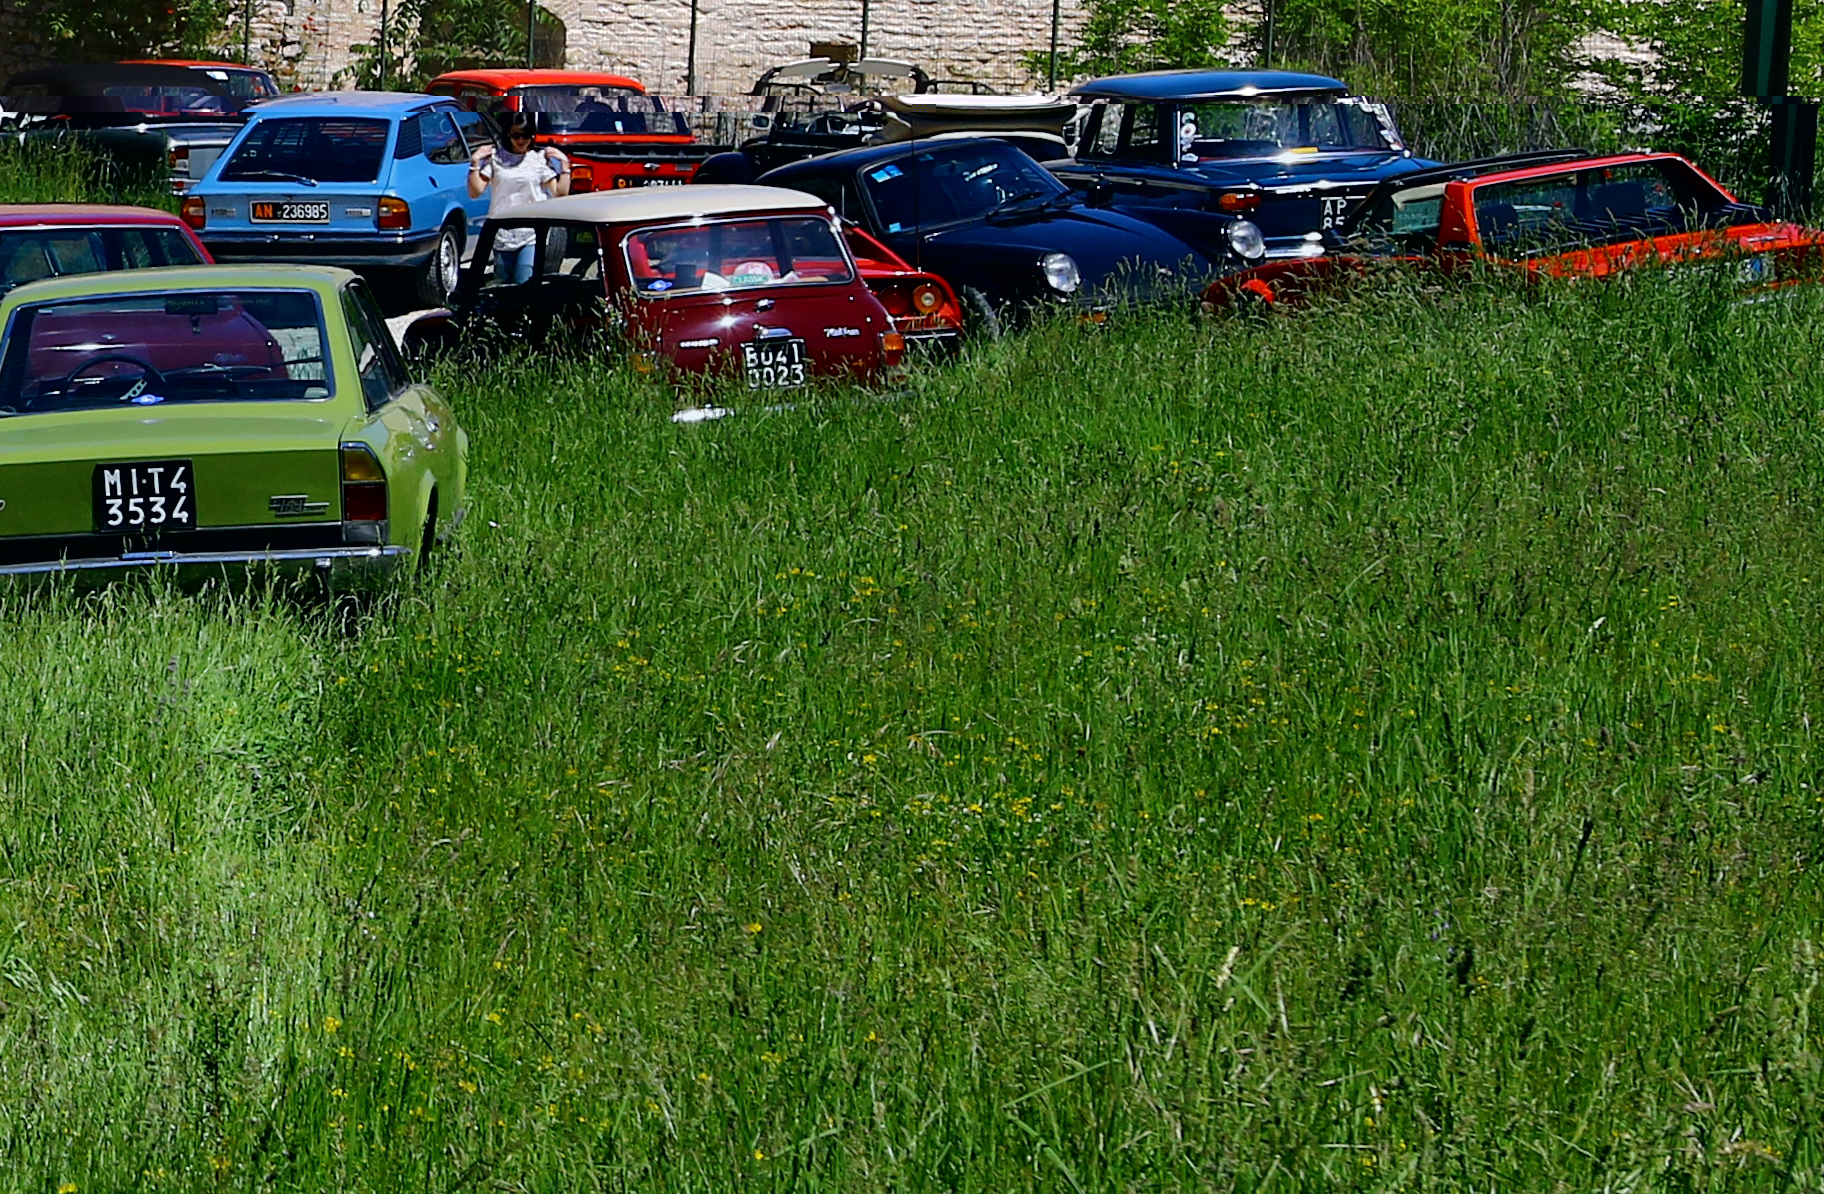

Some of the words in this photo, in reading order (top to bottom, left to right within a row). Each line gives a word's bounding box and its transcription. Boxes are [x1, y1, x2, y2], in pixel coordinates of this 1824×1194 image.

[255, 204, 273, 218] AN
[282, 204, 328, 219] 236985
[1323, 199, 1346, 215] AP
[104, 496, 188, 525] 3534
